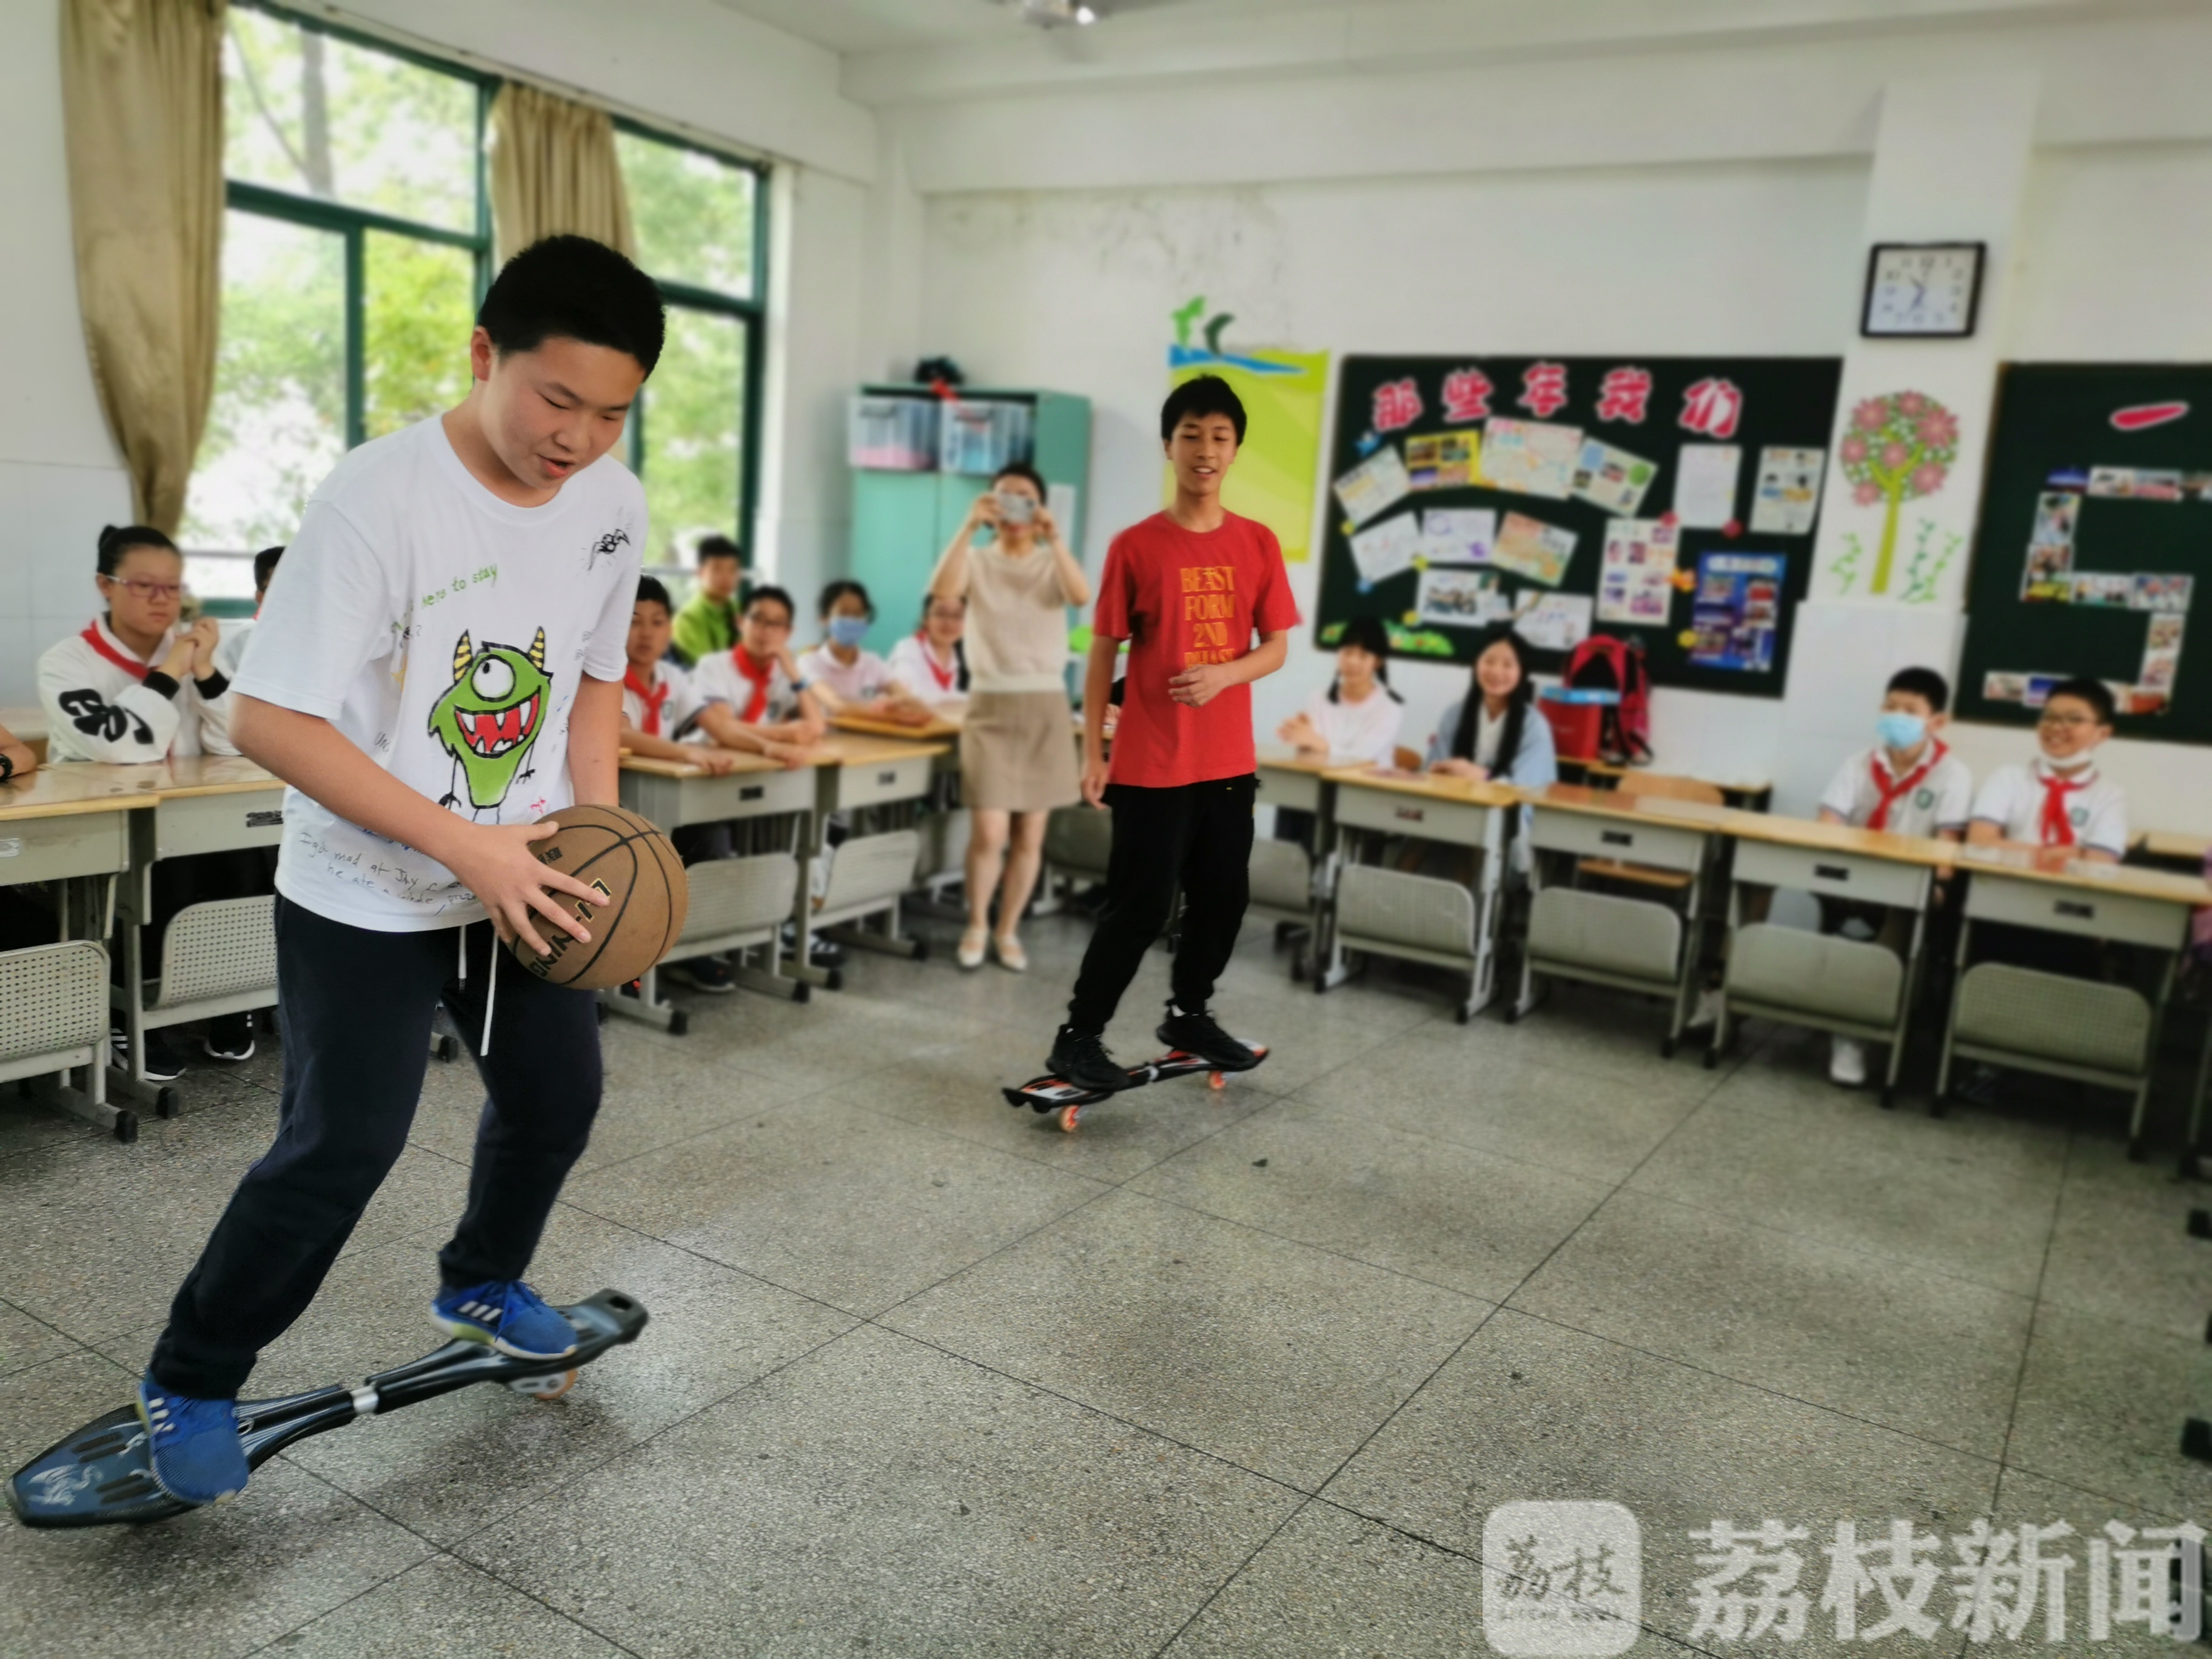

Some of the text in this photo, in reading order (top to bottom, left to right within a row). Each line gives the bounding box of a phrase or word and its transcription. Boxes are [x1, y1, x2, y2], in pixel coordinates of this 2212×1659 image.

[451, 577, 466, 592] to
[1184, 594, 1235, 620] FORM
[327, 862, 343, 879] he
[352, 873, 374, 888] ate
[370, 862, 391, 876] at
